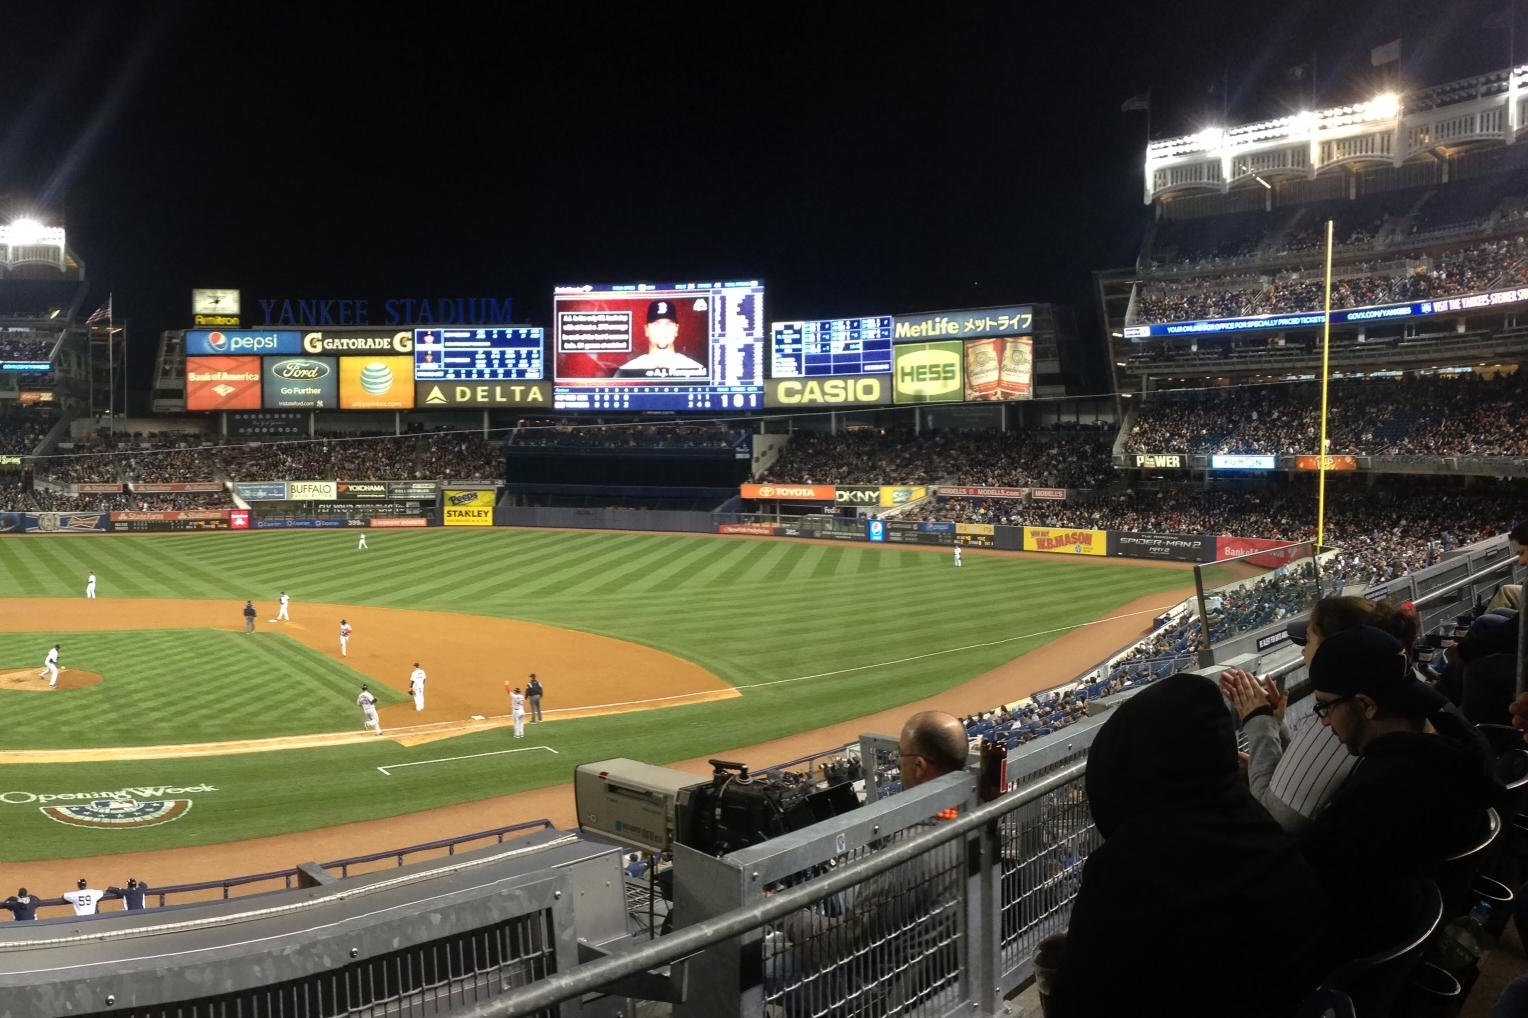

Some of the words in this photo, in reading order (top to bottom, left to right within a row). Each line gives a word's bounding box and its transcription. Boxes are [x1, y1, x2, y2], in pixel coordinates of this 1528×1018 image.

[262, 299, 368, 325] YANKEE
[385, 299, 513, 325] STADIUM
[895, 317, 960, 338] MetLife
[964, 314, 1032, 333] メットライフ
[230, 334, 278, 351] pepsi
[323, 338, 391, 350] GATORADE
[283, 361, 318, 378] Ford
[901, 363, 956, 383] HESS
[189, 373, 211, 381] Bank
[221, 373, 259, 381] America
[280, 387, 293, 395] Go
[293, 387, 321, 395] Further
[455, 386, 544, 402] DELTA
[776, 378, 881, 404] CASIO
[290, 484, 332, 494] BUFFALO
[776, 488, 815, 497] TOYOTA
[836, 489, 880, 502] DKNY
[448, 492, 478, 506] Peeps
[447, 510, 489, 518] STANLEY
[1120, 537, 1191, 548] SPIDER-MAN
[1225, 547, 1246, 556] Bank
[123, 783, 220, 797] Week
[78, 896, 92, 907] 59
